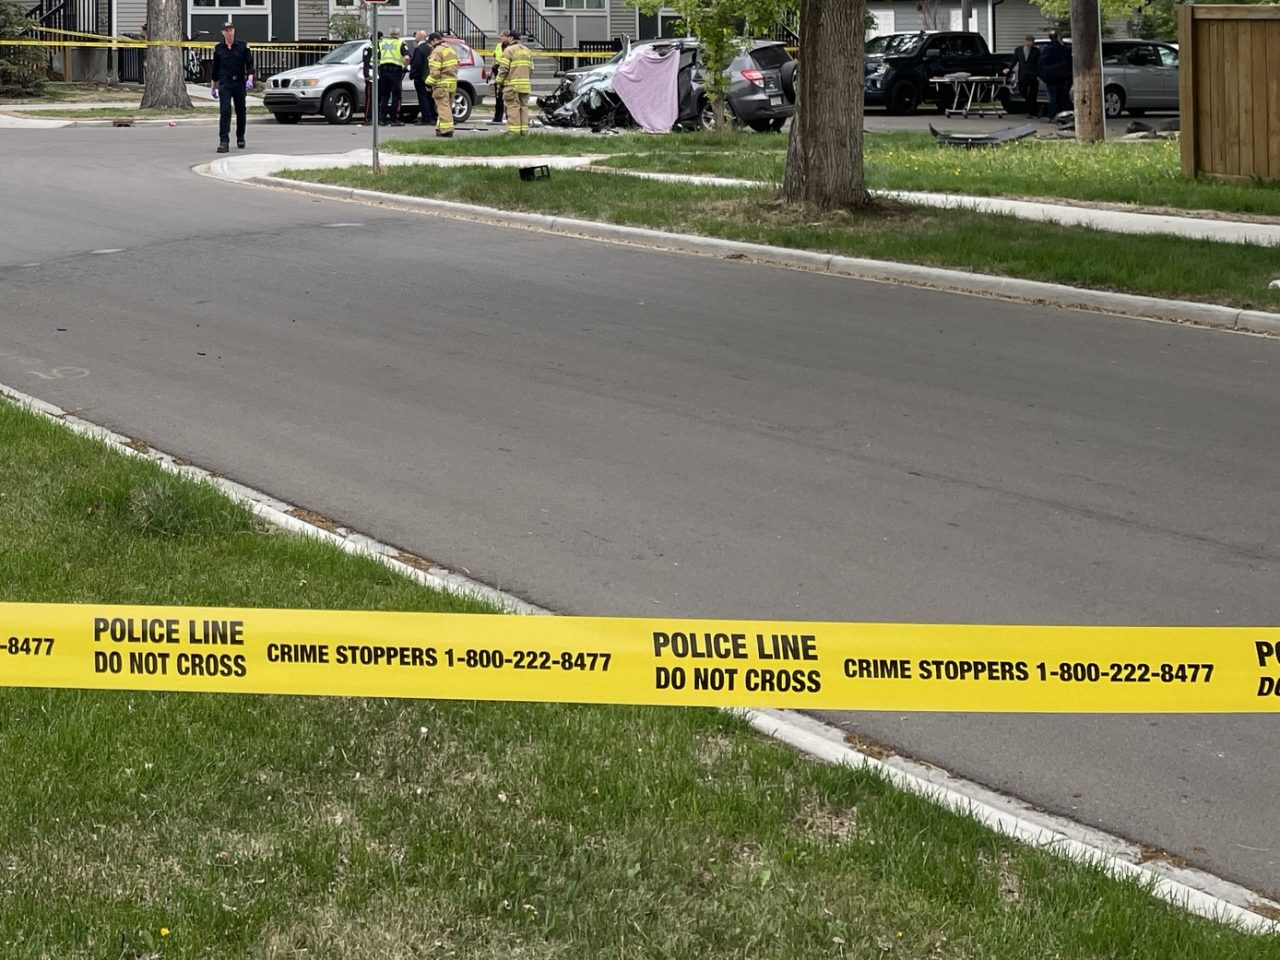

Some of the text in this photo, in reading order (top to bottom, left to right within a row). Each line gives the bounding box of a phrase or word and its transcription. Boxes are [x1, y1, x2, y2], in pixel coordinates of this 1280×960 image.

[94, 618, 244, 646] POLICE LINE
[267, 644, 612, 672] CRIME STOPPERS 1-800-222-8477
[652, 632, 819, 661] POLICE LINE
[94, 652, 247, 678] DO NOT CROSS
[843, 659, 1214, 683] CRIME STOPPERS 1-800-222-8477
[655, 667, 821, 693] DO NOT CROSS
